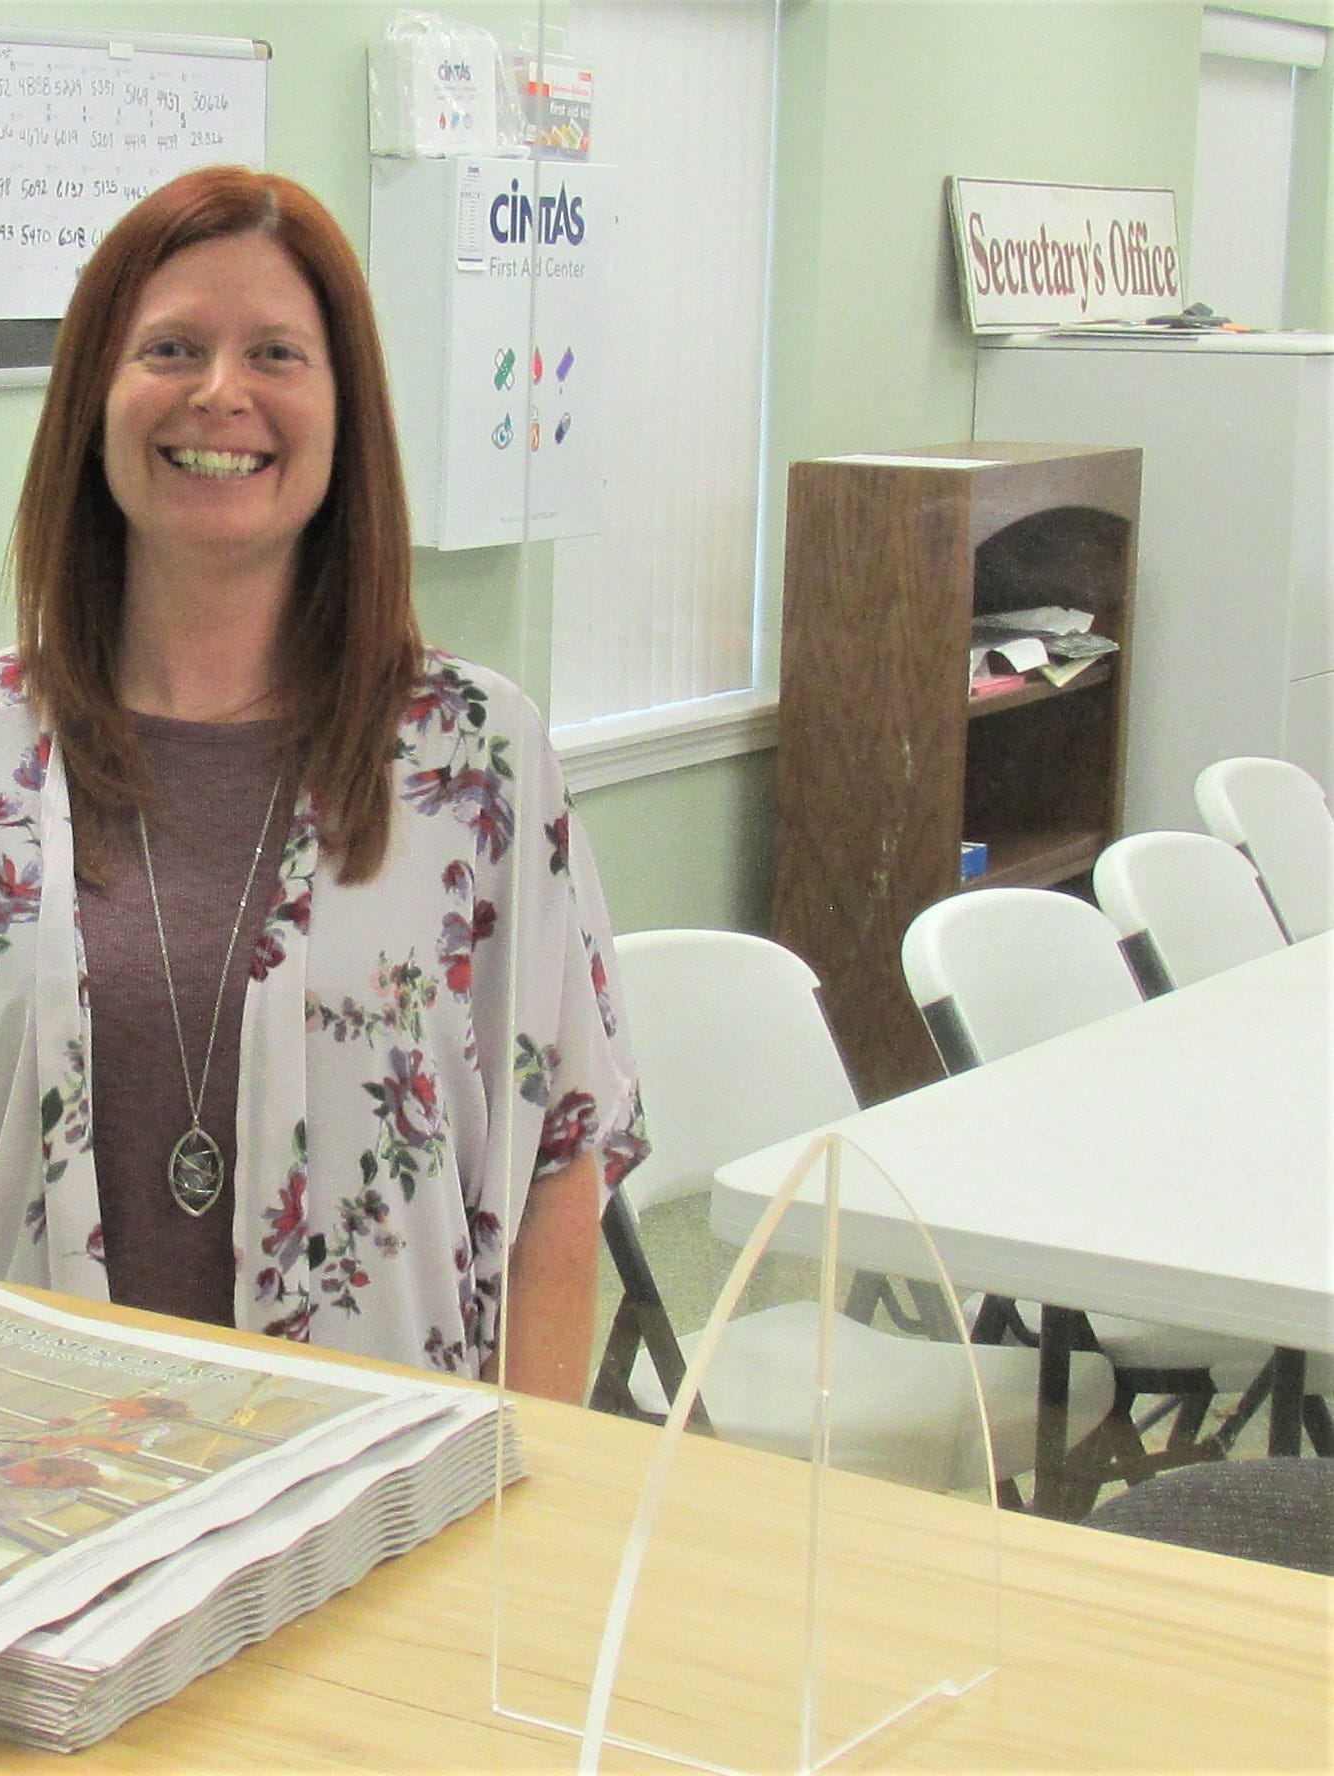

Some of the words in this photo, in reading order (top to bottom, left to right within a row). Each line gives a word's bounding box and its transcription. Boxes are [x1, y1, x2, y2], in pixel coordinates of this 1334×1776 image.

[21, 178, 49, 199] 5092
[57, 180, 85, 197] 6137
[21, 224, 51, 246] 5470
[490, 255, 517, 277] First
[546, 256, 586, 278] Center
[969, 211, 1106, 313] Secretary's
[1109, 219, 1178, 297] Office
